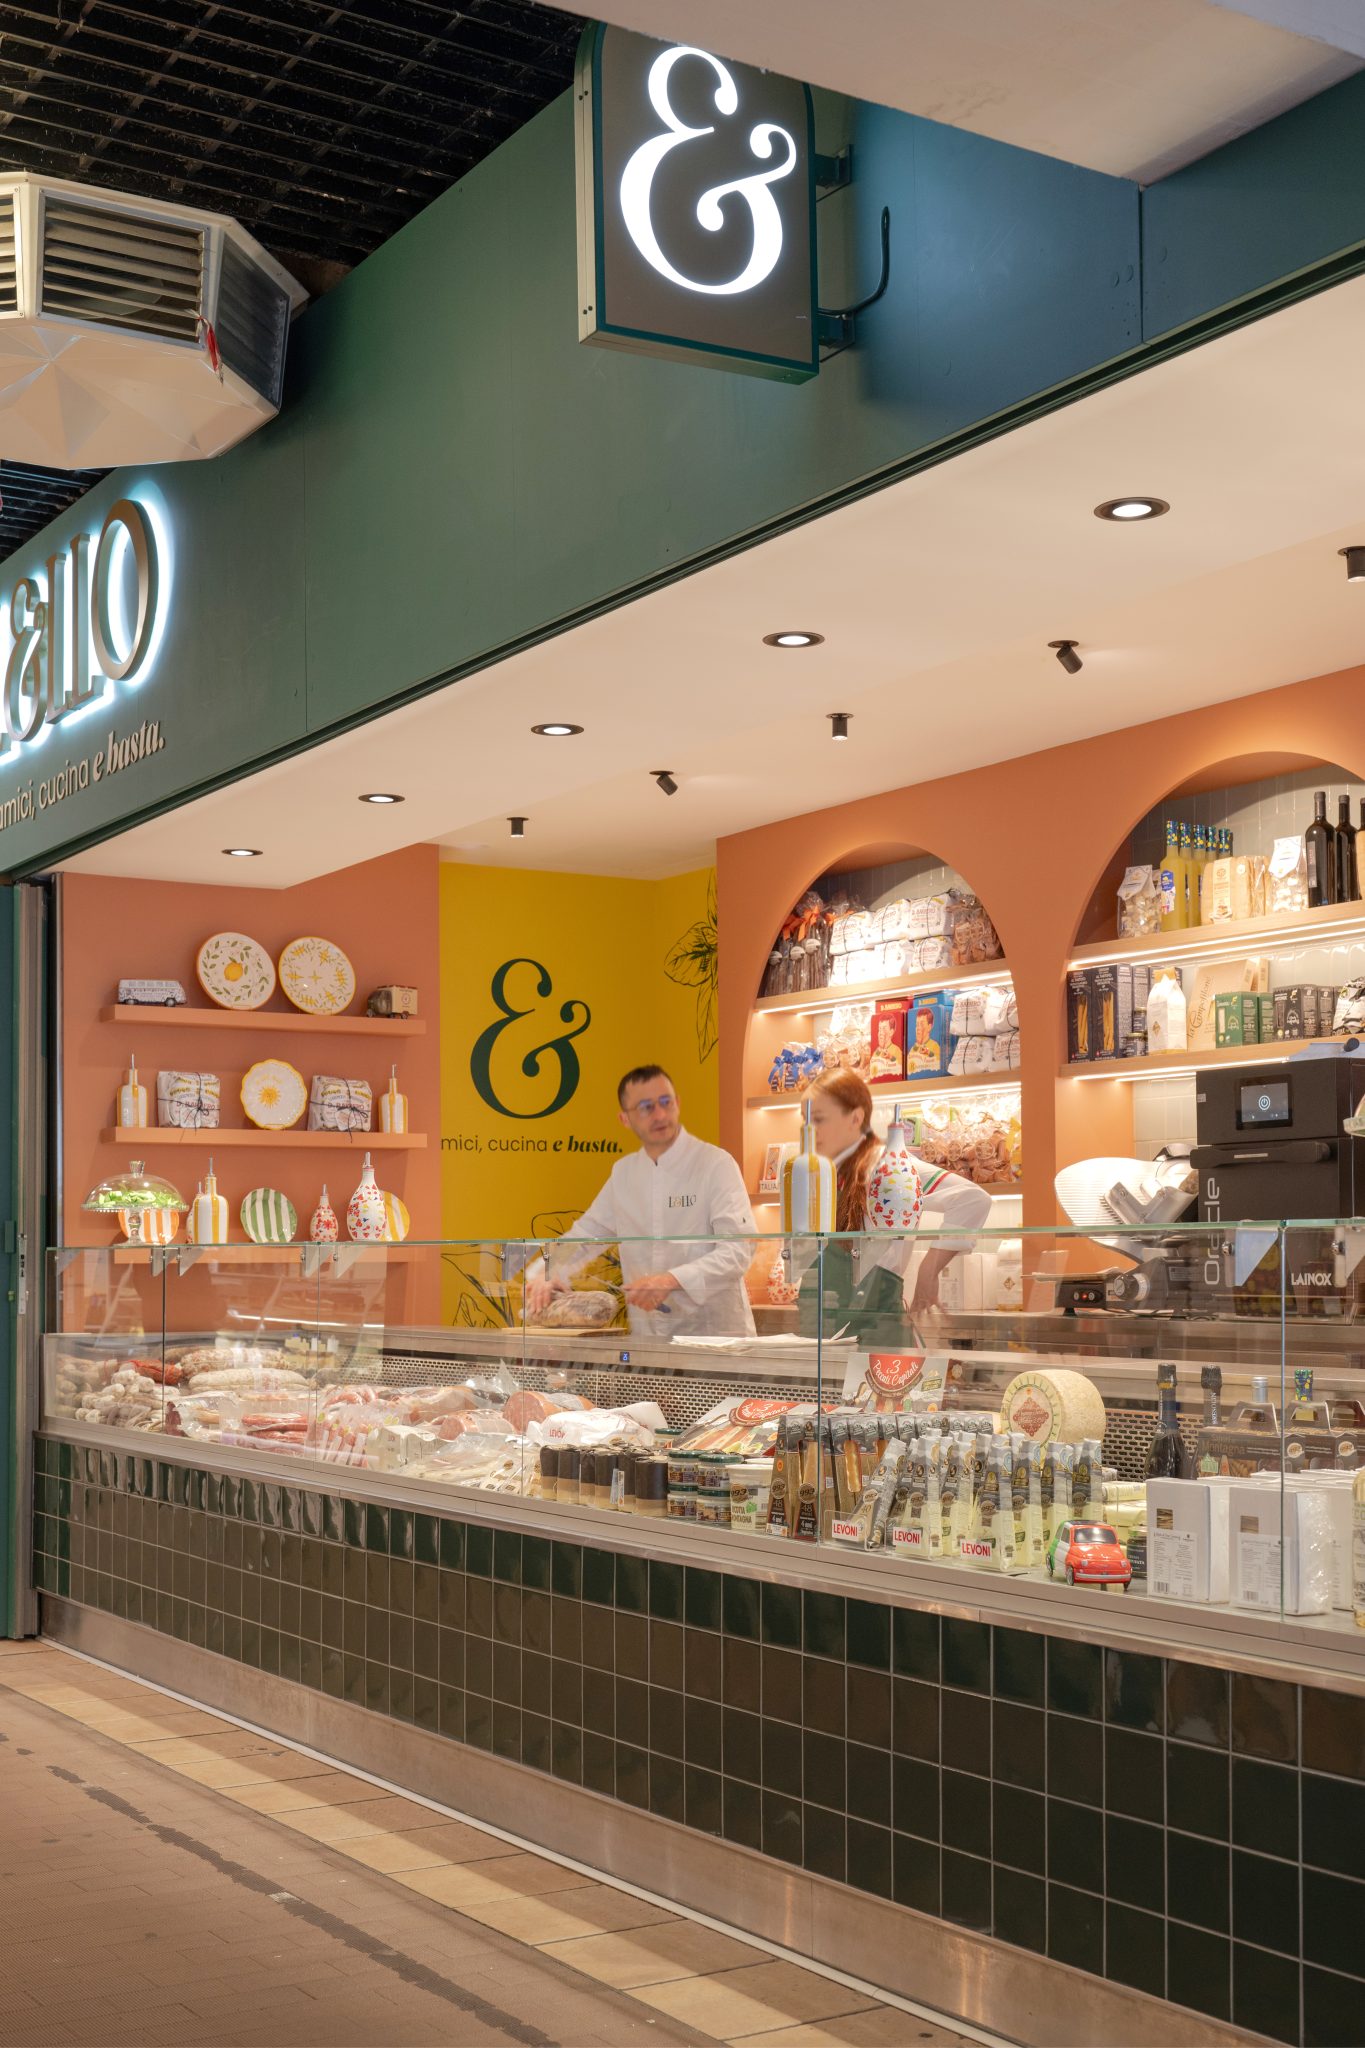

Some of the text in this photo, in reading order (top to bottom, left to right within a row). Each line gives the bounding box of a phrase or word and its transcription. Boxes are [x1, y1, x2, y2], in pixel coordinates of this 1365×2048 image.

[620, 46, 797, 295] &
[38, 758, 90, 810] cucina
[92, 750, 105, 784] e
[106, 718, 165, 776] basta.
[470, 958, 591, 1119] &
[441, 1134, 623, 1153] mici, cucina e basta.
[1291, 1272, 1332, 1286] LAINOX
[833, 1523, 858, 1537] LEVONI
[894, 1531, 920, 1545] LEVONI
[961, 1543, 991, 1557] LEVONI
